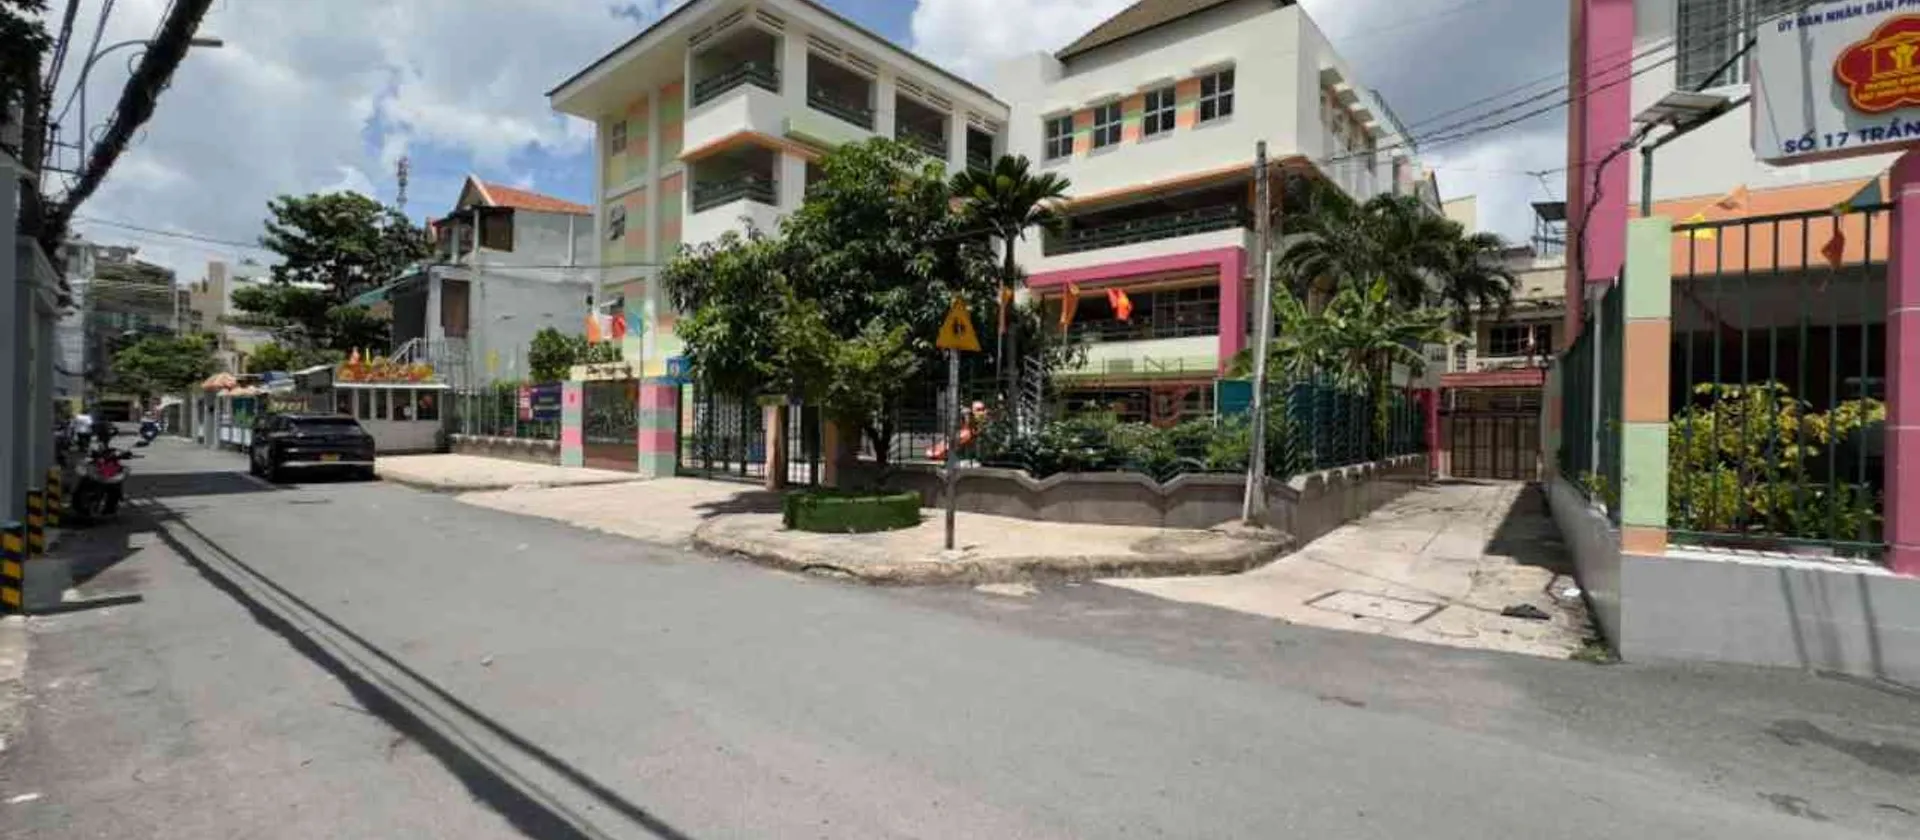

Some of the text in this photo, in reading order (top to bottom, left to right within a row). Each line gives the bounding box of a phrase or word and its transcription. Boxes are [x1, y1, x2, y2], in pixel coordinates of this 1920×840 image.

[1826, 5, 1862, 21] NHÂN
[1785, 129, 1816, 153] SỐ
[1824, 132, 1848, 147] 17
